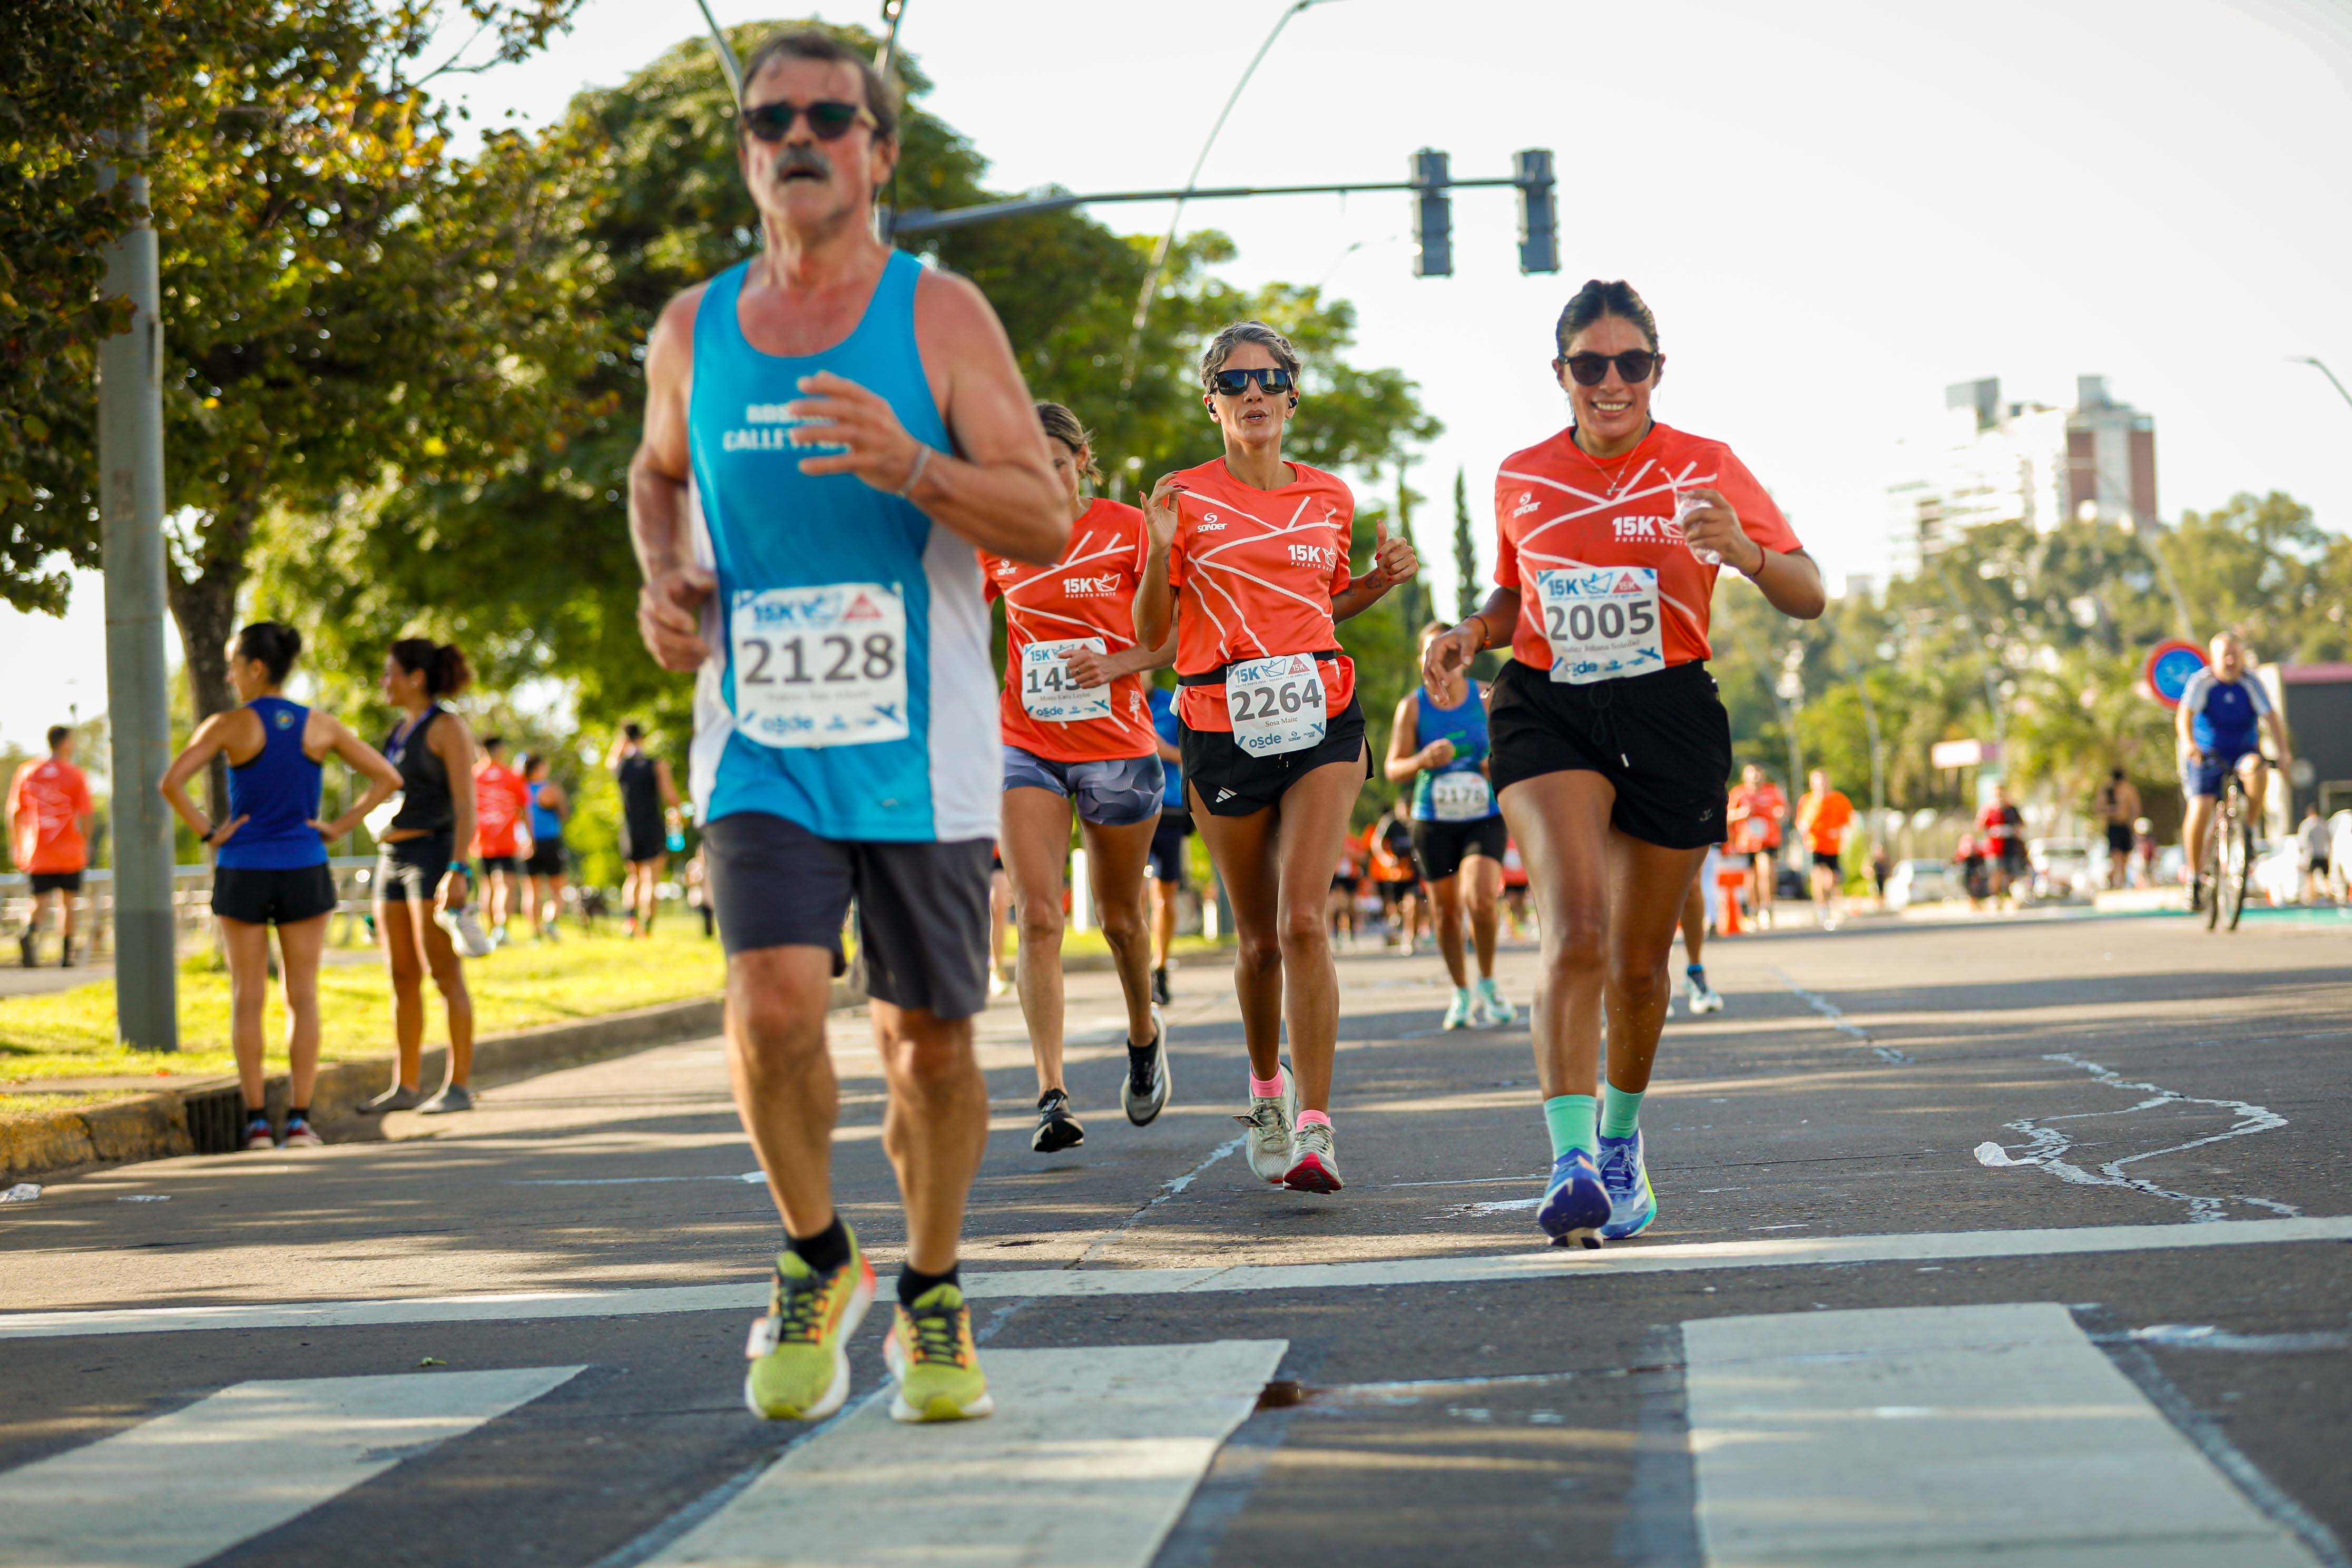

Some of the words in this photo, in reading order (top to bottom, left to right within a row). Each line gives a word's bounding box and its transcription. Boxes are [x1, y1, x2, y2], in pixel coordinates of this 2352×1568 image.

[1612, 516, 1656, 536] 15K
[1288, 544, 1321, 562] 15K
[1063, 577, 1093, 593] 15K
[1549, 578, 1579, 596] 15K
[1619, 581, 1636, 591] 15K
[1546, 600, 1654, 641] 2005
[742, 633, 895, 684] 2128
[1031, 649, 1051, 661] 15K
[1234, 666, 1261, 683] 15K
[1292, 663, 1306, 671] 15K
[1027, 666, 1081, 693] 145
[1231, 679, 1322, 722] 2264
[1036, 706, 1064, 717] osde
[1249, 733, 1282, 749] osde
